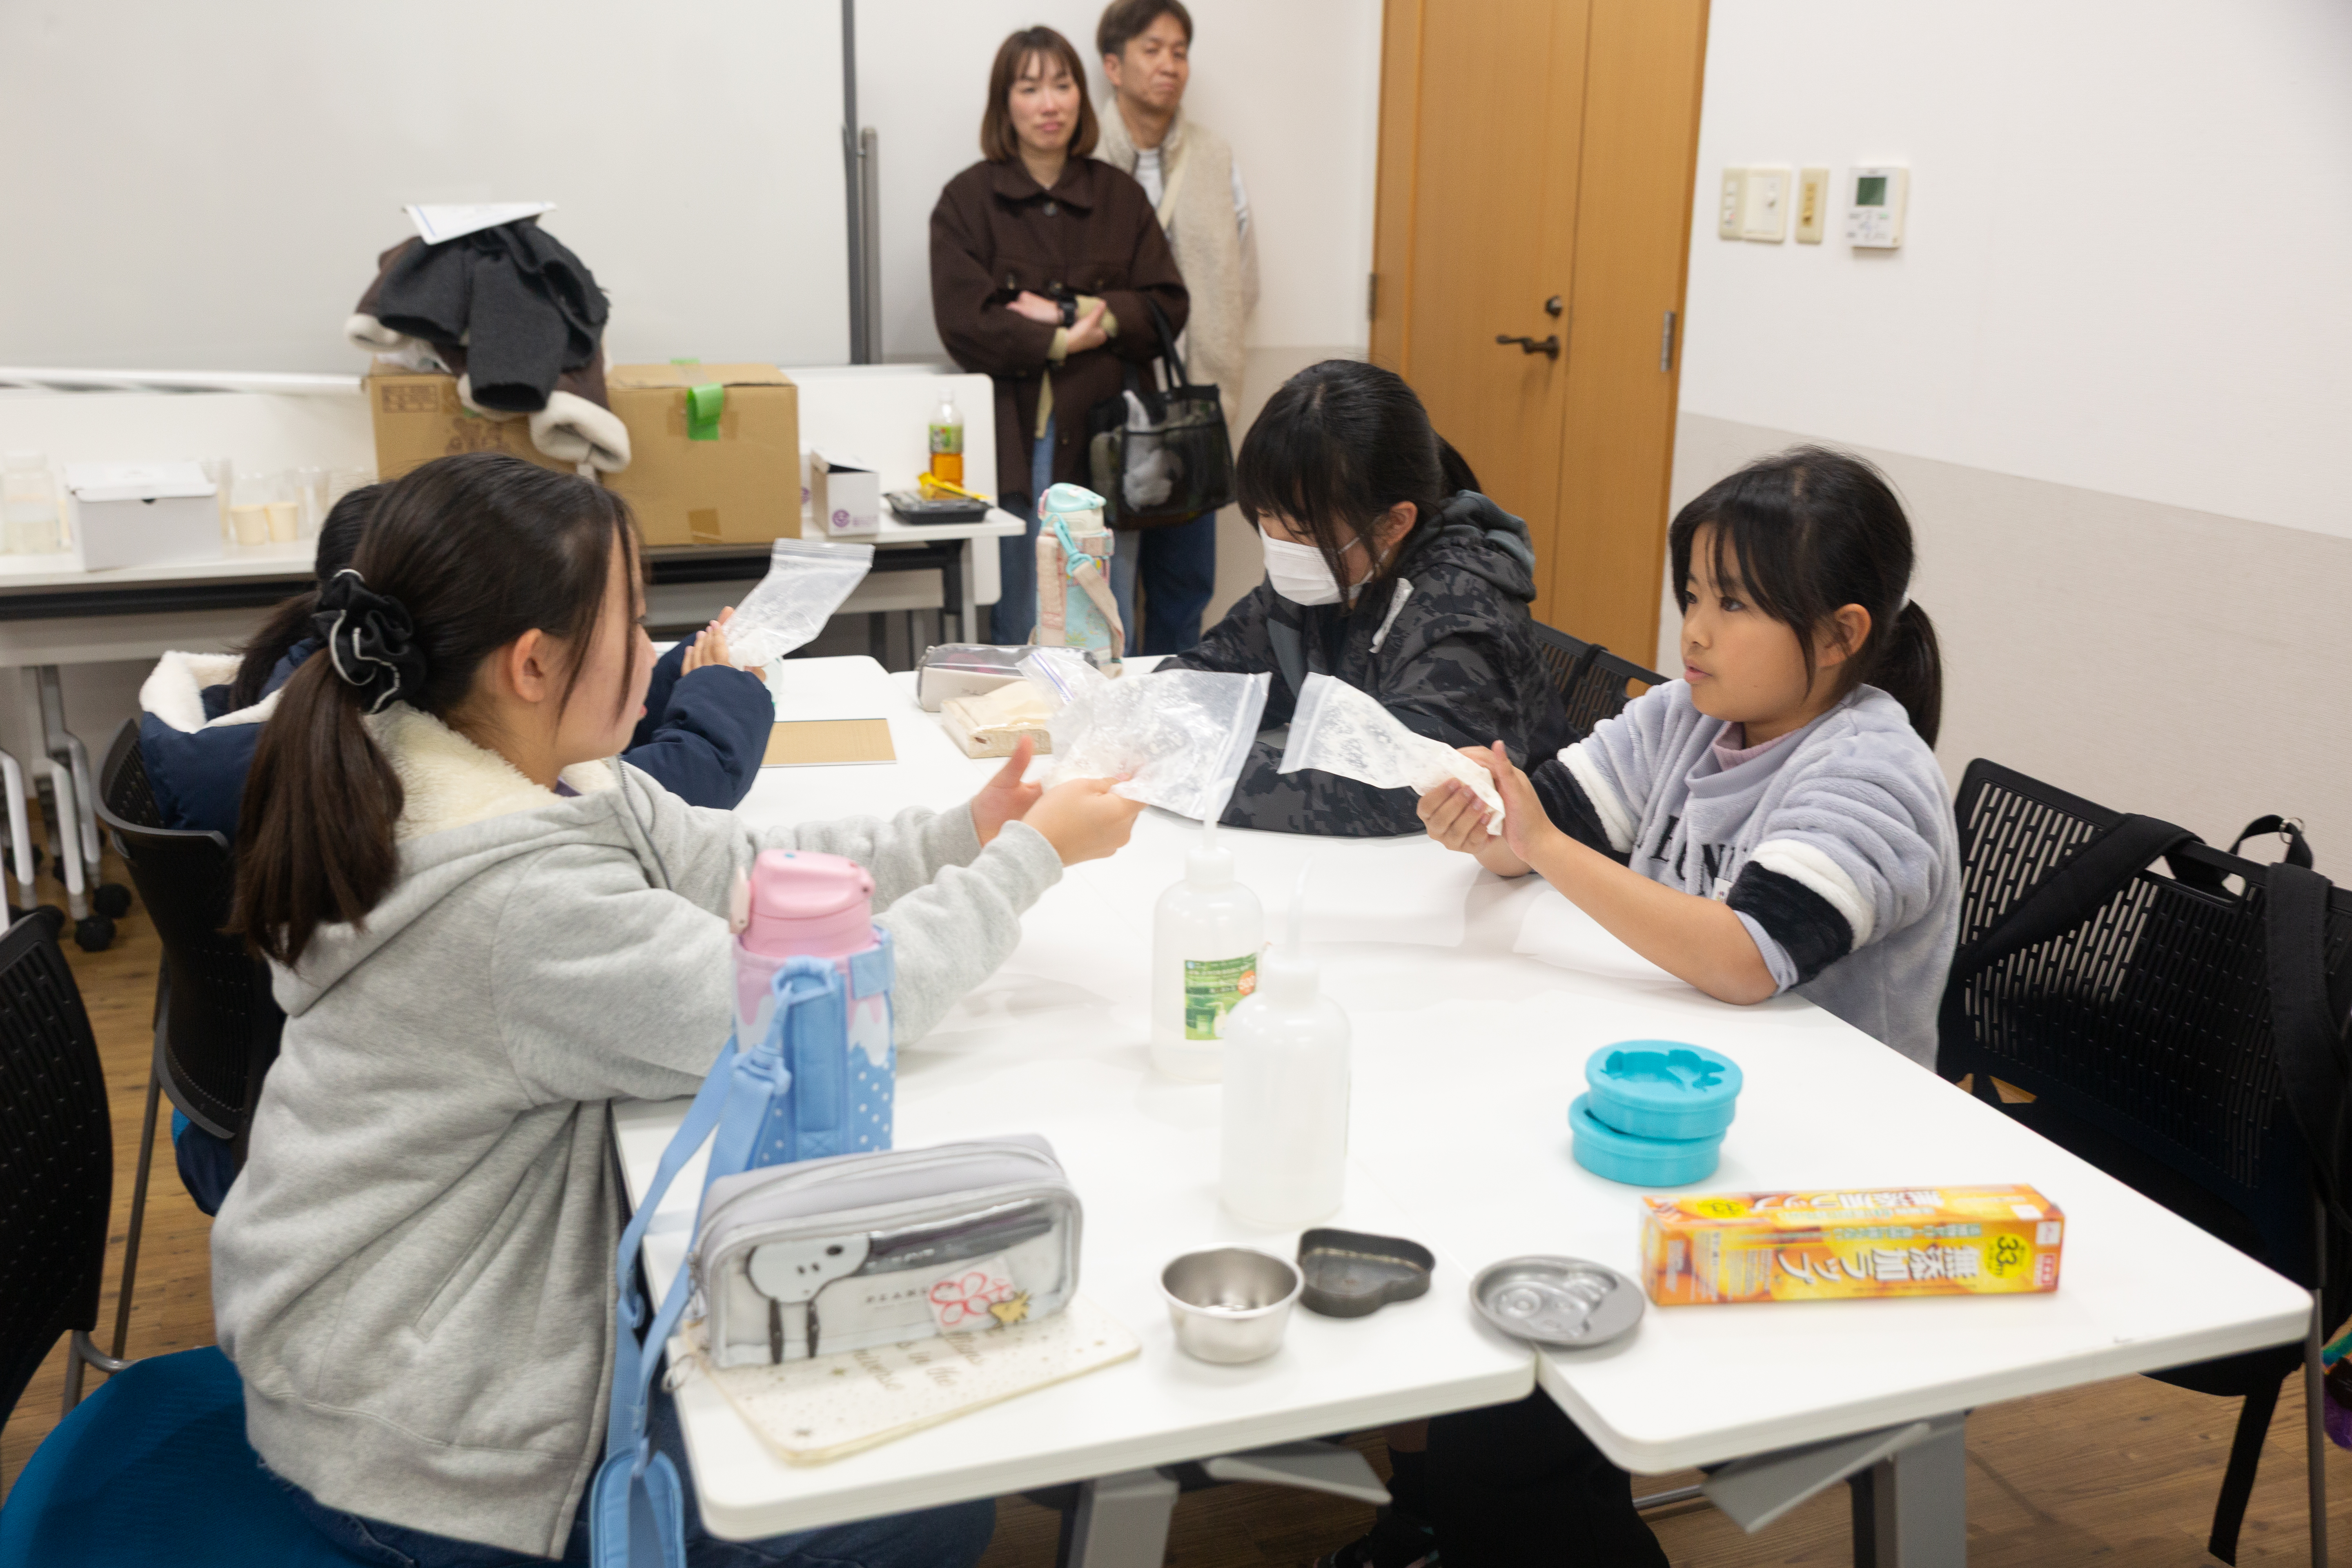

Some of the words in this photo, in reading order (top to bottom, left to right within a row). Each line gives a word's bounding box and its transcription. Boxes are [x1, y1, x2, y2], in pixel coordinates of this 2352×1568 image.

[1776, 1244, 1980, 1285] 無添加ラップ
[1996, 1236, 2019, 1276] 33m
